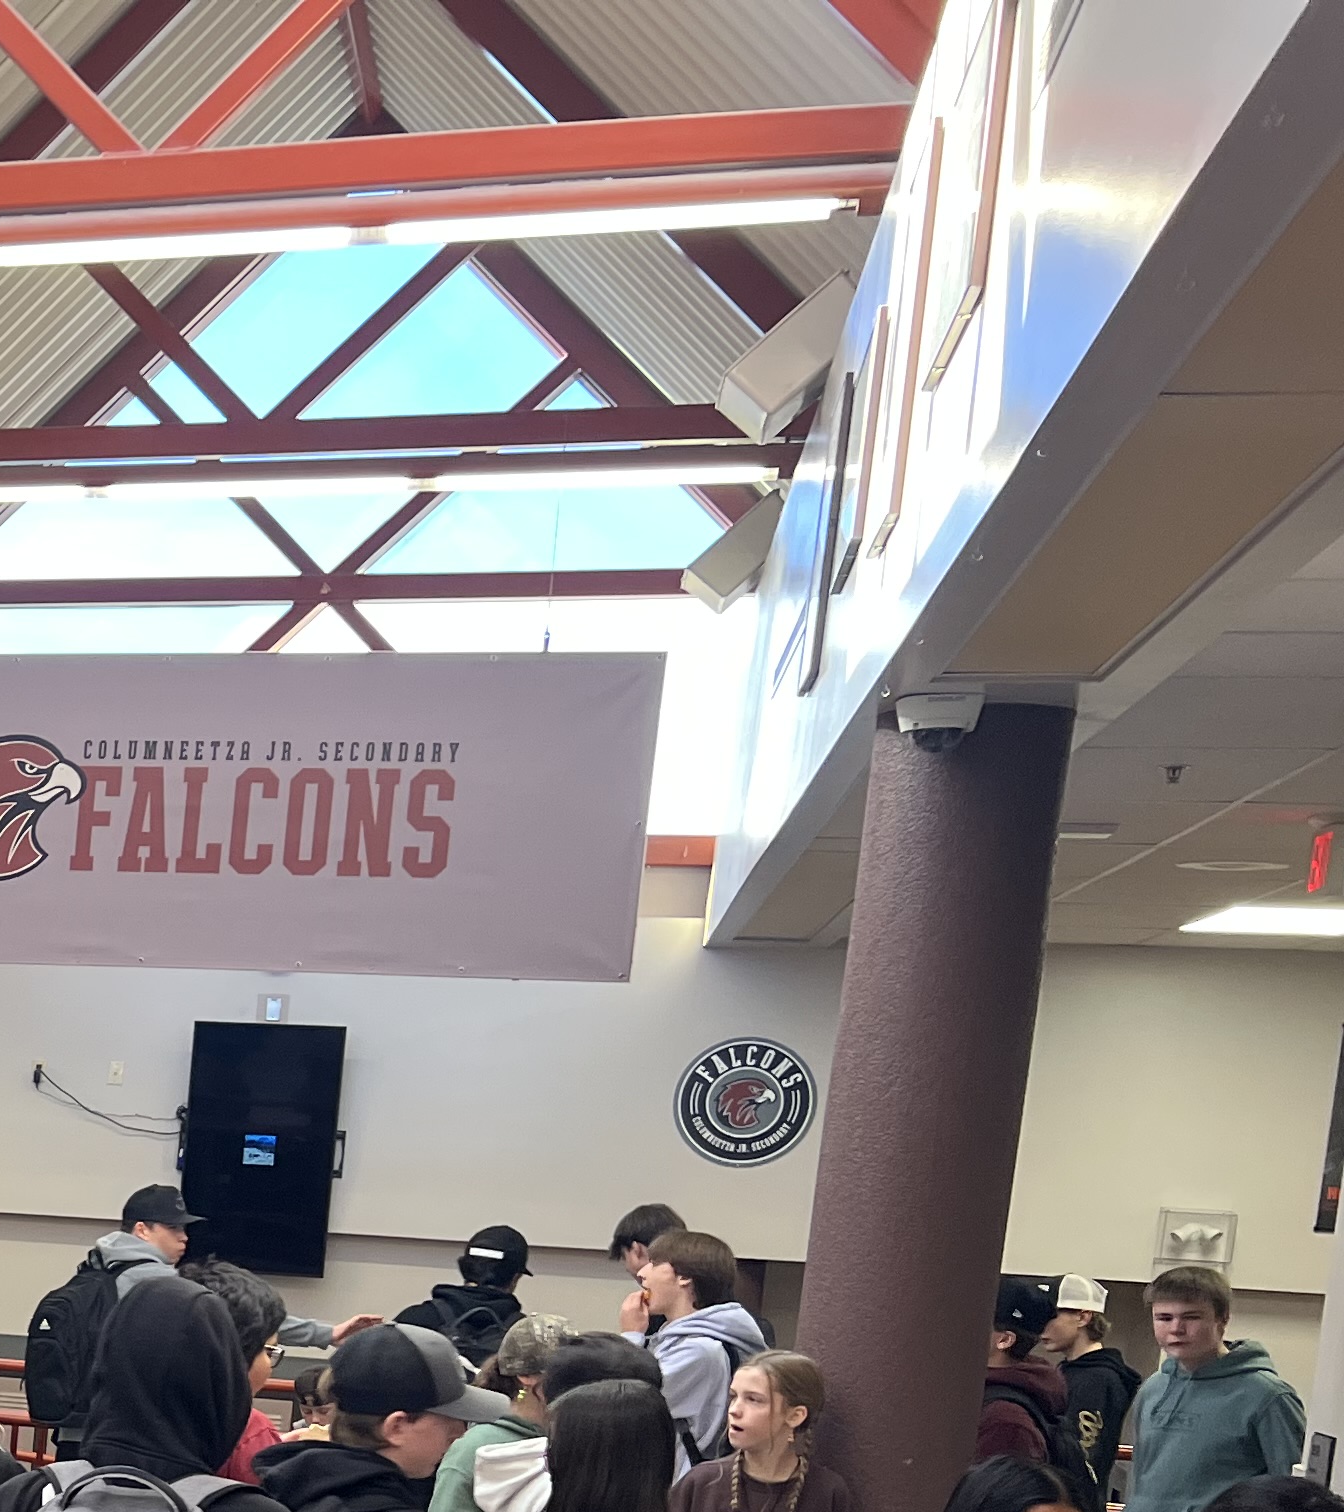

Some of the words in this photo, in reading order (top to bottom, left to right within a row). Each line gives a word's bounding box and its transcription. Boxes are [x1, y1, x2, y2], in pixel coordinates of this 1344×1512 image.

[83, 739, 251, 762] COLUMNEETZA
[265, 741, 303, 762] JR.
[317, 741, 461, 764] SECONDARY
[69, 766, 456, 878] FALCONS
[695, 1045, 803, 1088] FALCONS
